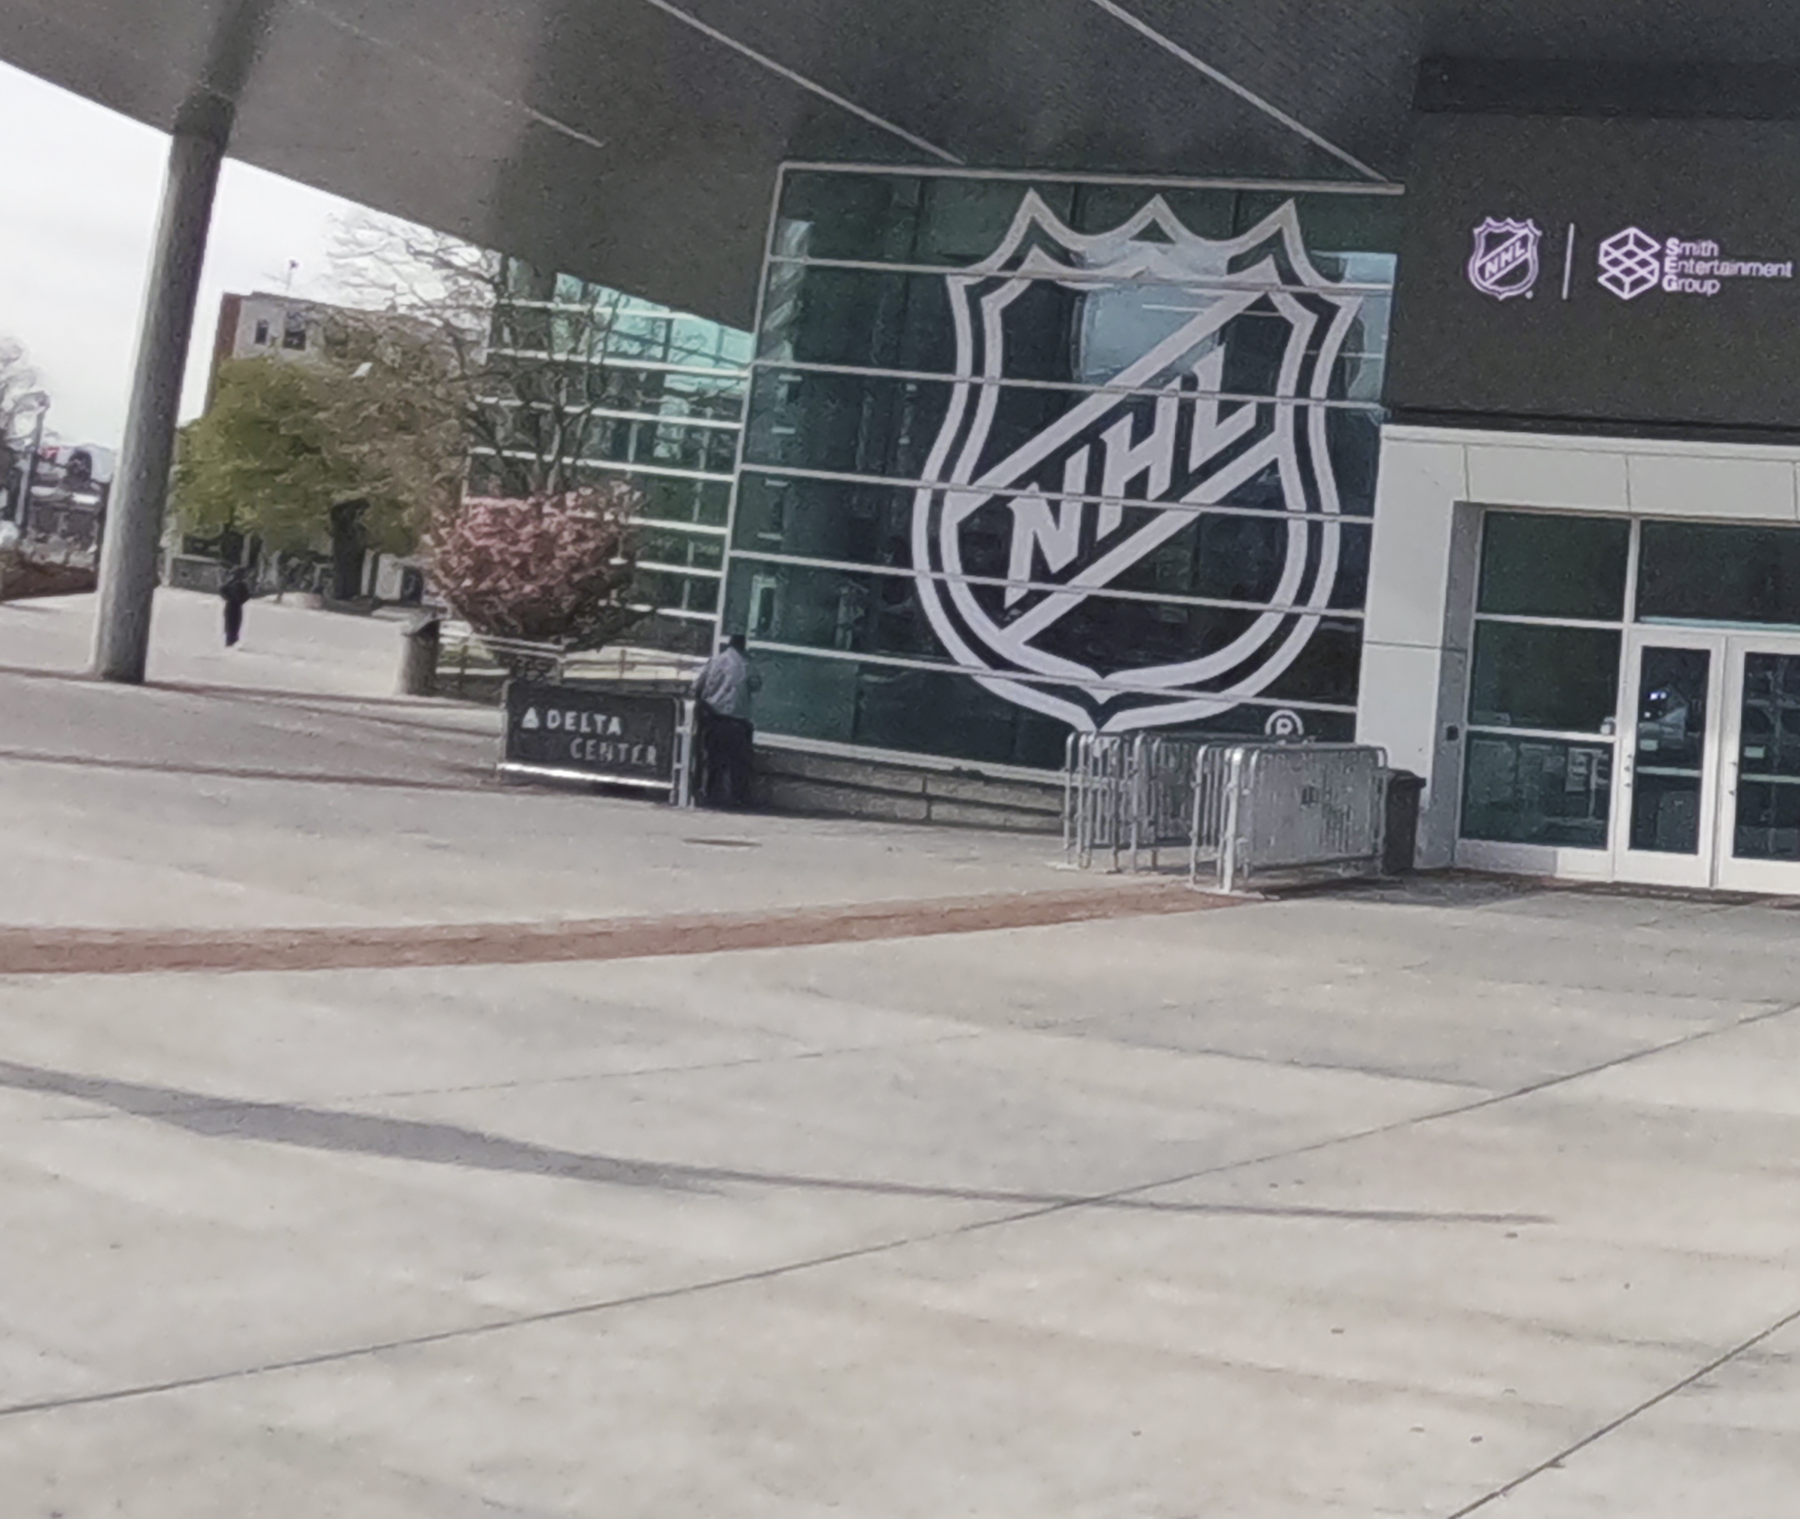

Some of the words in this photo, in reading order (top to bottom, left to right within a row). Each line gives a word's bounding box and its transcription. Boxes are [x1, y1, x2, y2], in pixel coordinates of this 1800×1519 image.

[1485, 240, 1525, 279] NHL
[1665, 237, 1719, 256] Smith
[1664, 256, 1793, 278] Entertainment
[1662, 275, 1721, 297] Group
[1003, 344, 1257, 611] NHL
[547, 709, 622, 736] DELTA
[570, 737, 657, 766] CENTER
